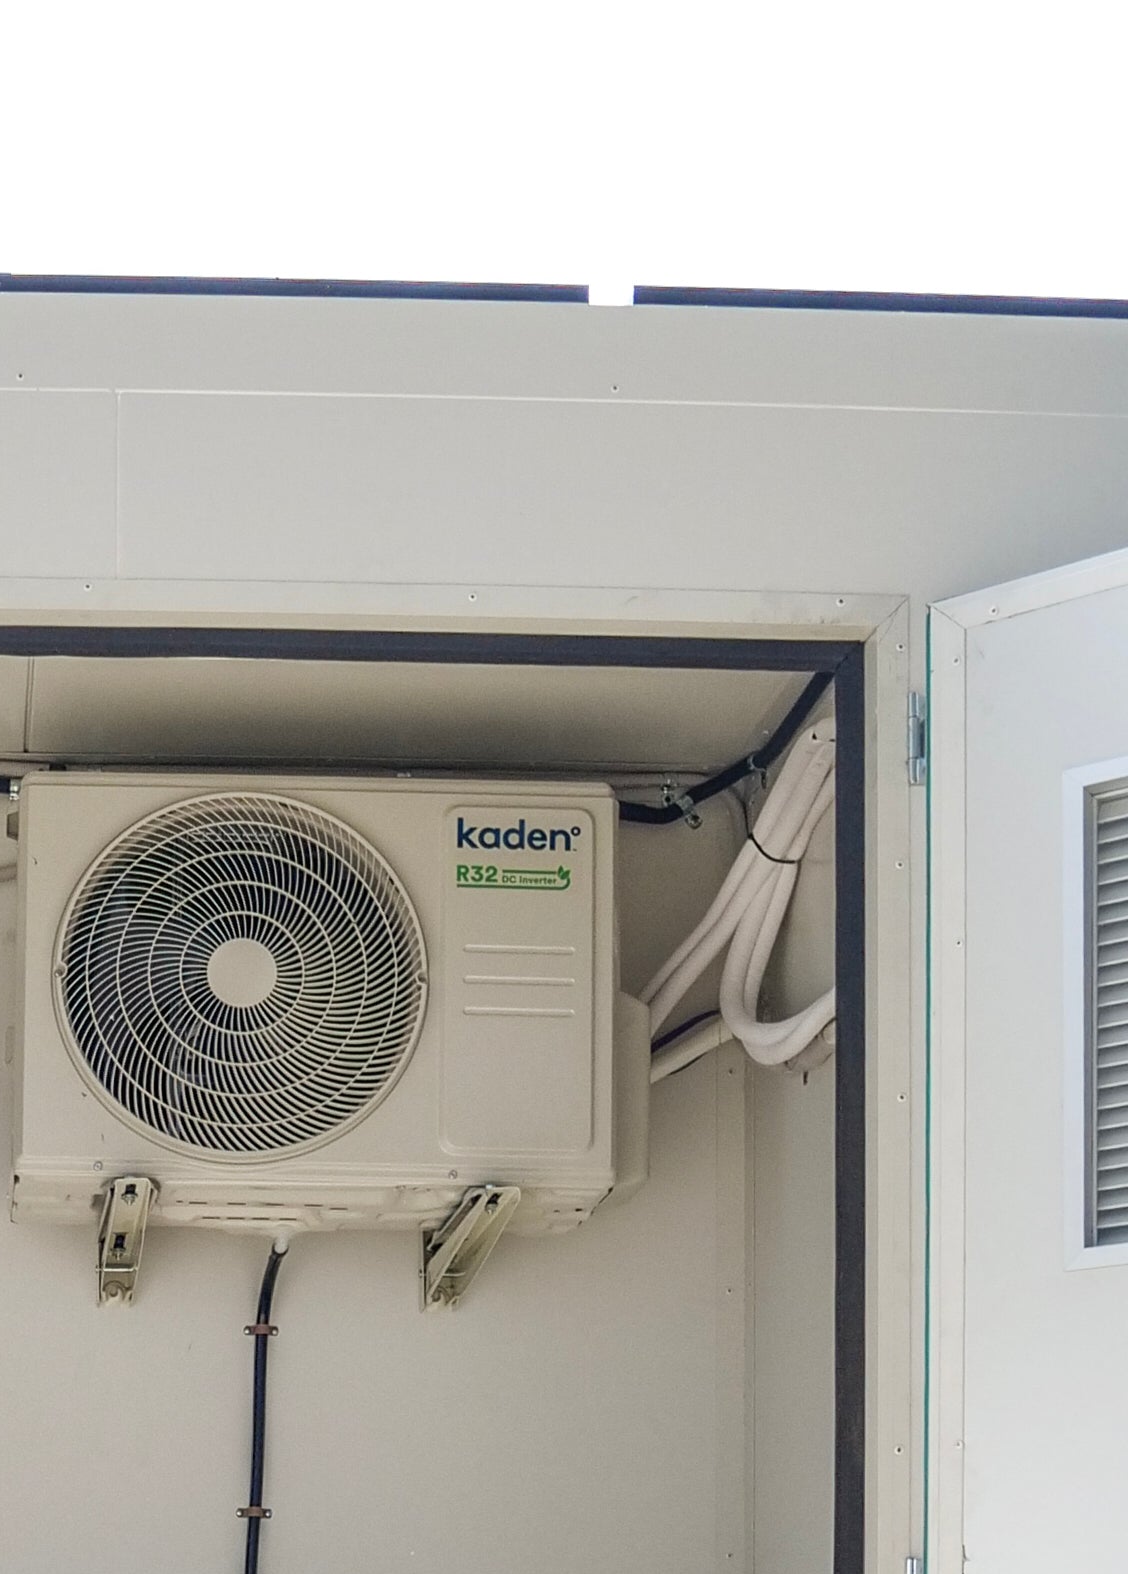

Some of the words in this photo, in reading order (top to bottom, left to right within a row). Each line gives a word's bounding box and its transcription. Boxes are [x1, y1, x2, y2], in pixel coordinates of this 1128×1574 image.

[456, 864, 499, 883] R32
[501, 875, 517, 884] DC
[519, 875, 558, 885] Inverter
